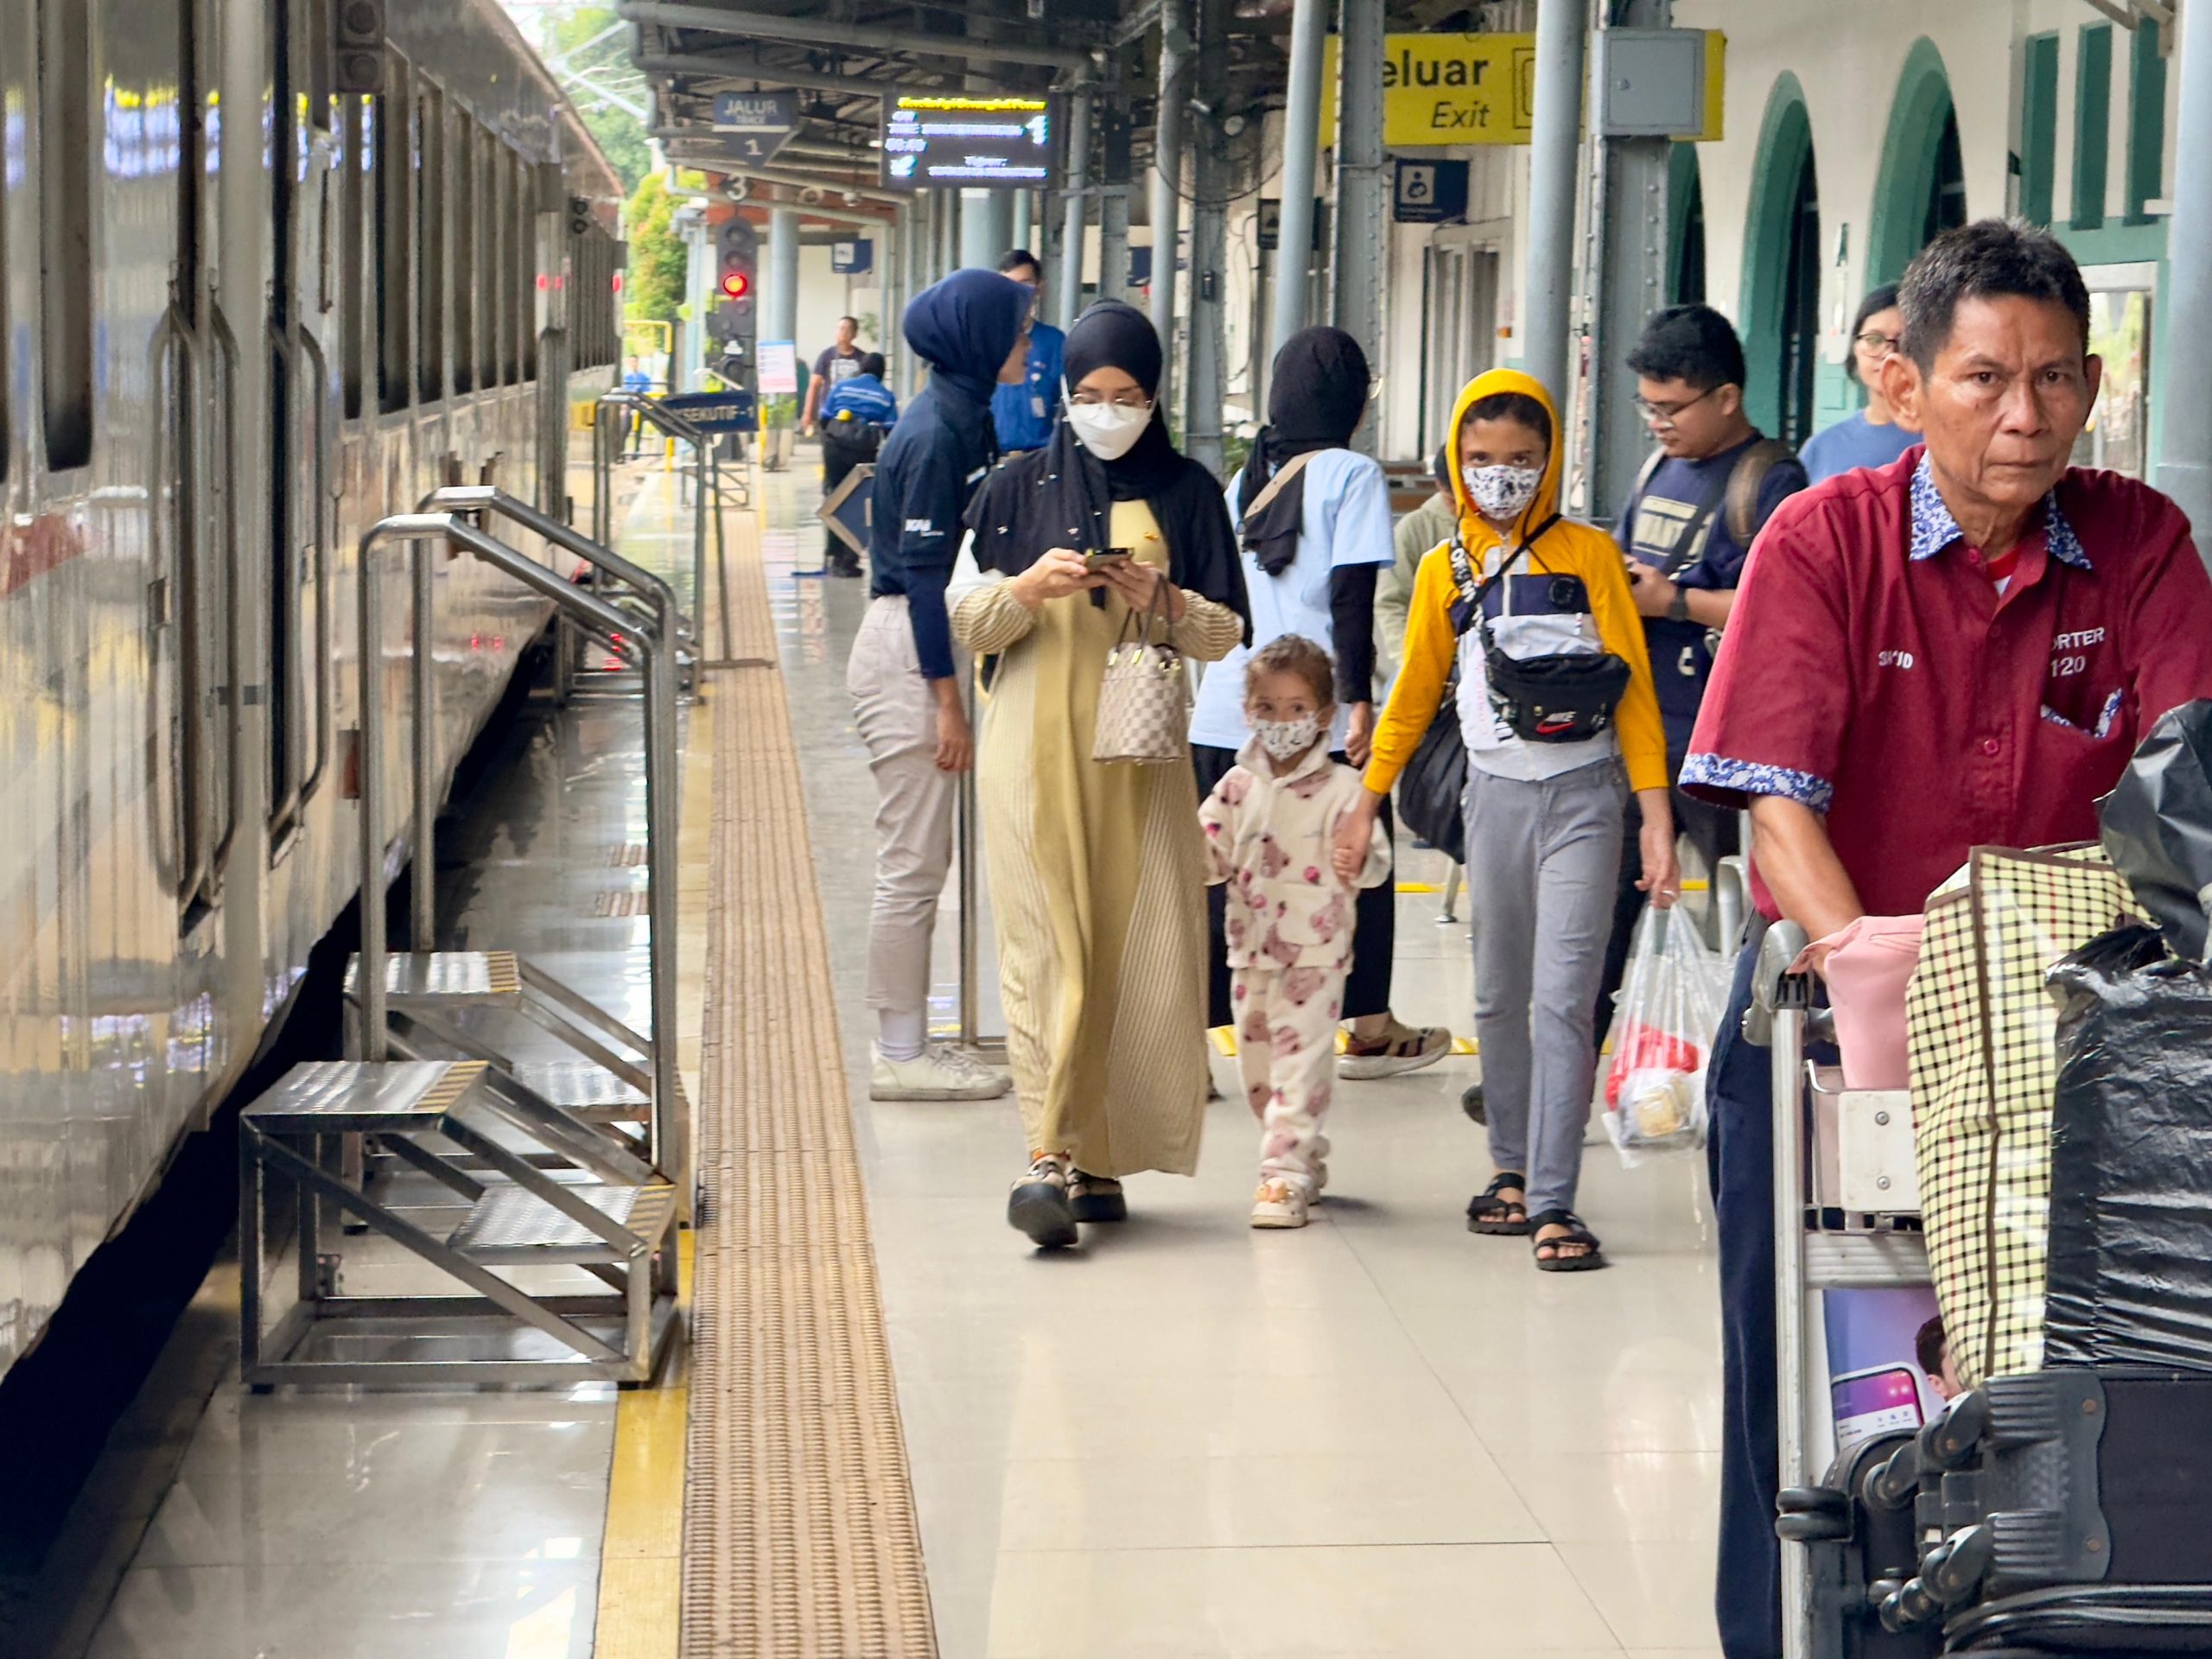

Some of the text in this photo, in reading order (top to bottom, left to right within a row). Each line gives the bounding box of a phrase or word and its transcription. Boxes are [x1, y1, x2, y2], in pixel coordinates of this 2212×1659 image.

[1382, 49, 1489, 88] eluar
[723, 99, 778, 117] JALUR
[1431, 100, 1491, 129] Exit
[744, 137, 764, 156] 1
[726, 174, 748, 201] 3
[2053, 626, 2105, 650] RTER
